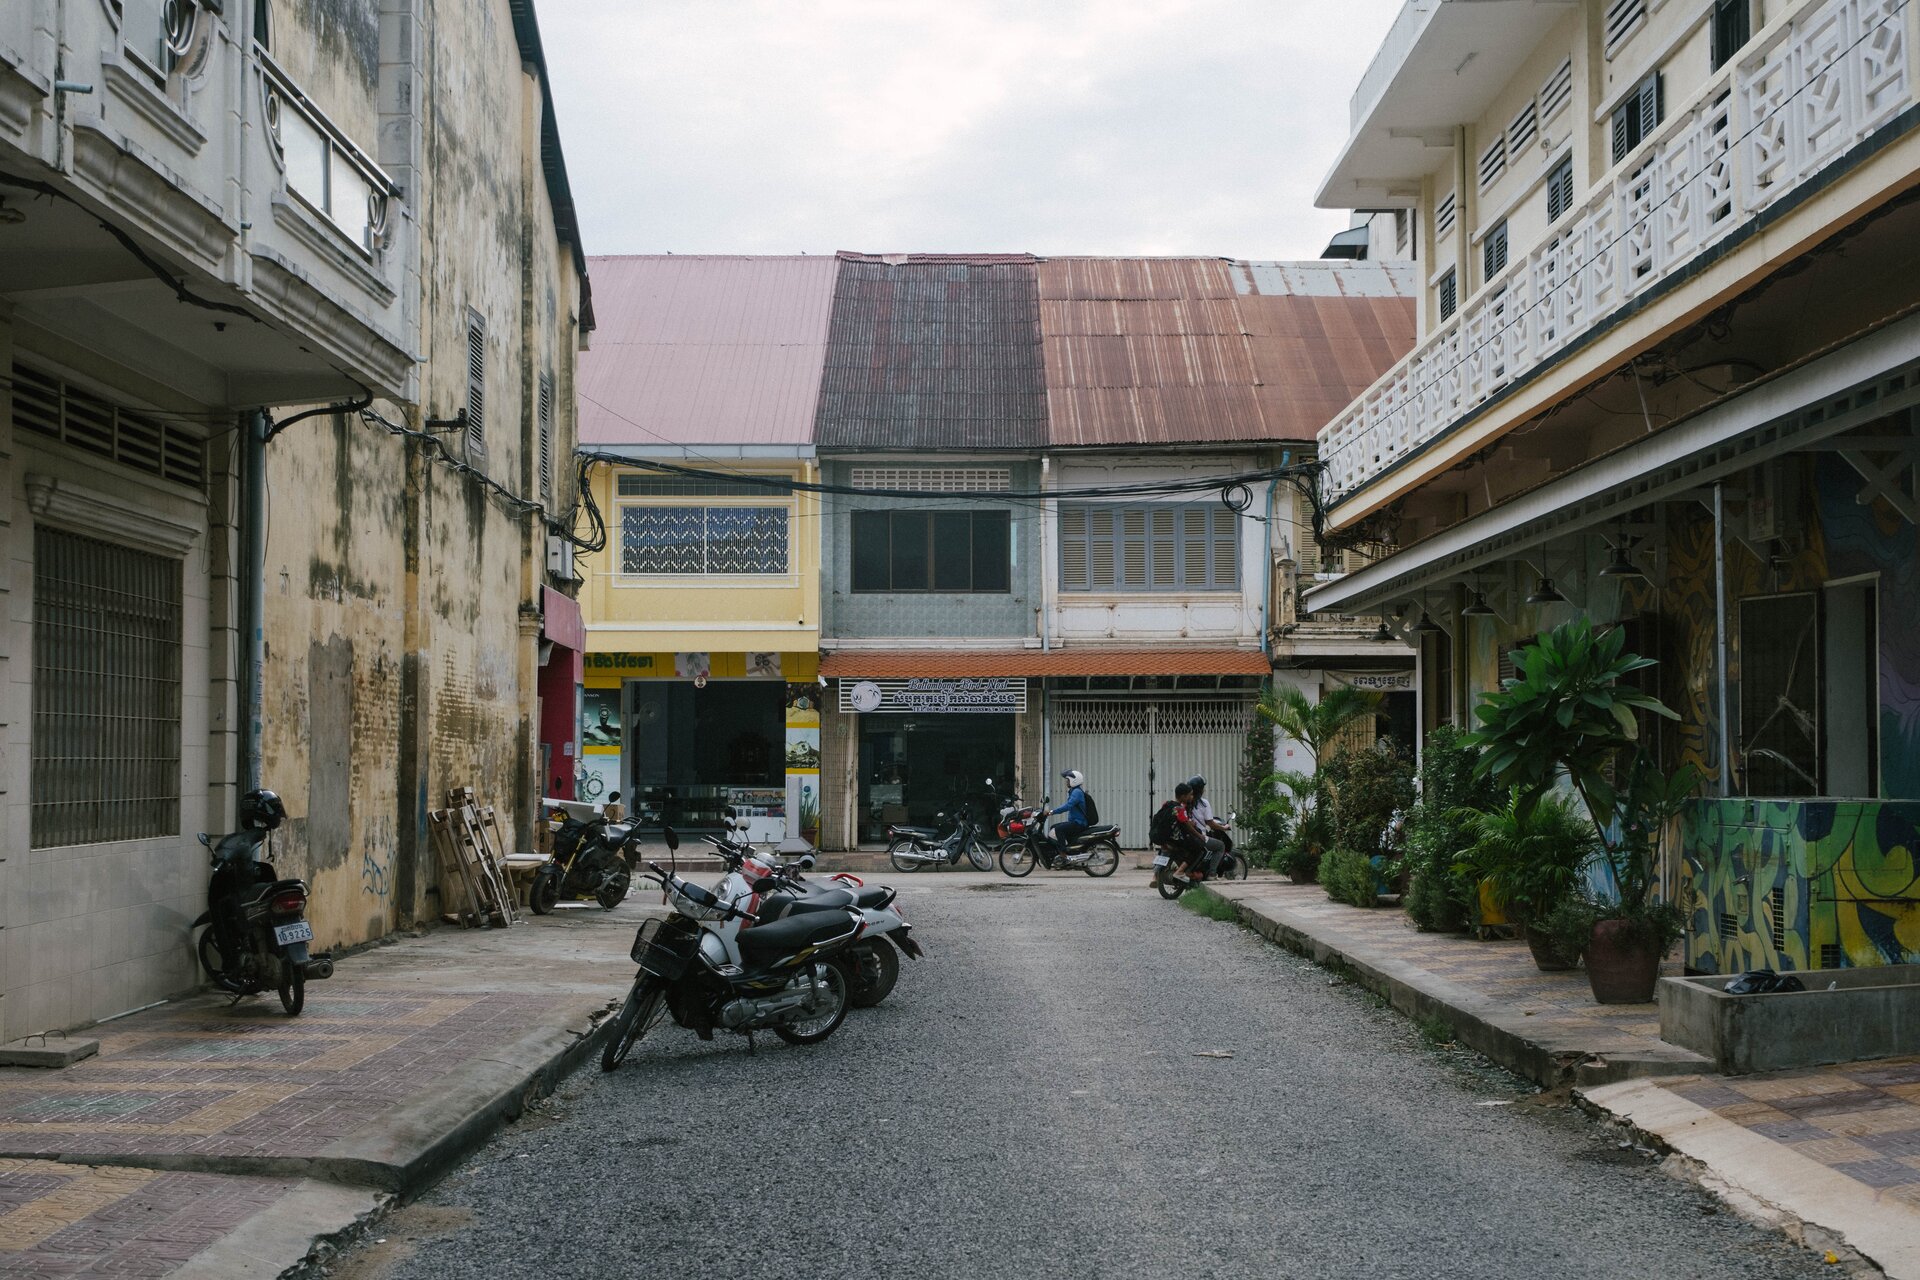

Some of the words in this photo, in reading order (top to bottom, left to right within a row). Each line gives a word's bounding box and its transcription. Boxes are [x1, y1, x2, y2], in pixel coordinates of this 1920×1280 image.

[908, 678, 956, 692] Battambang
[959, 678, 982, 690] Bird
[984, 678, 1008, 690] Nest
